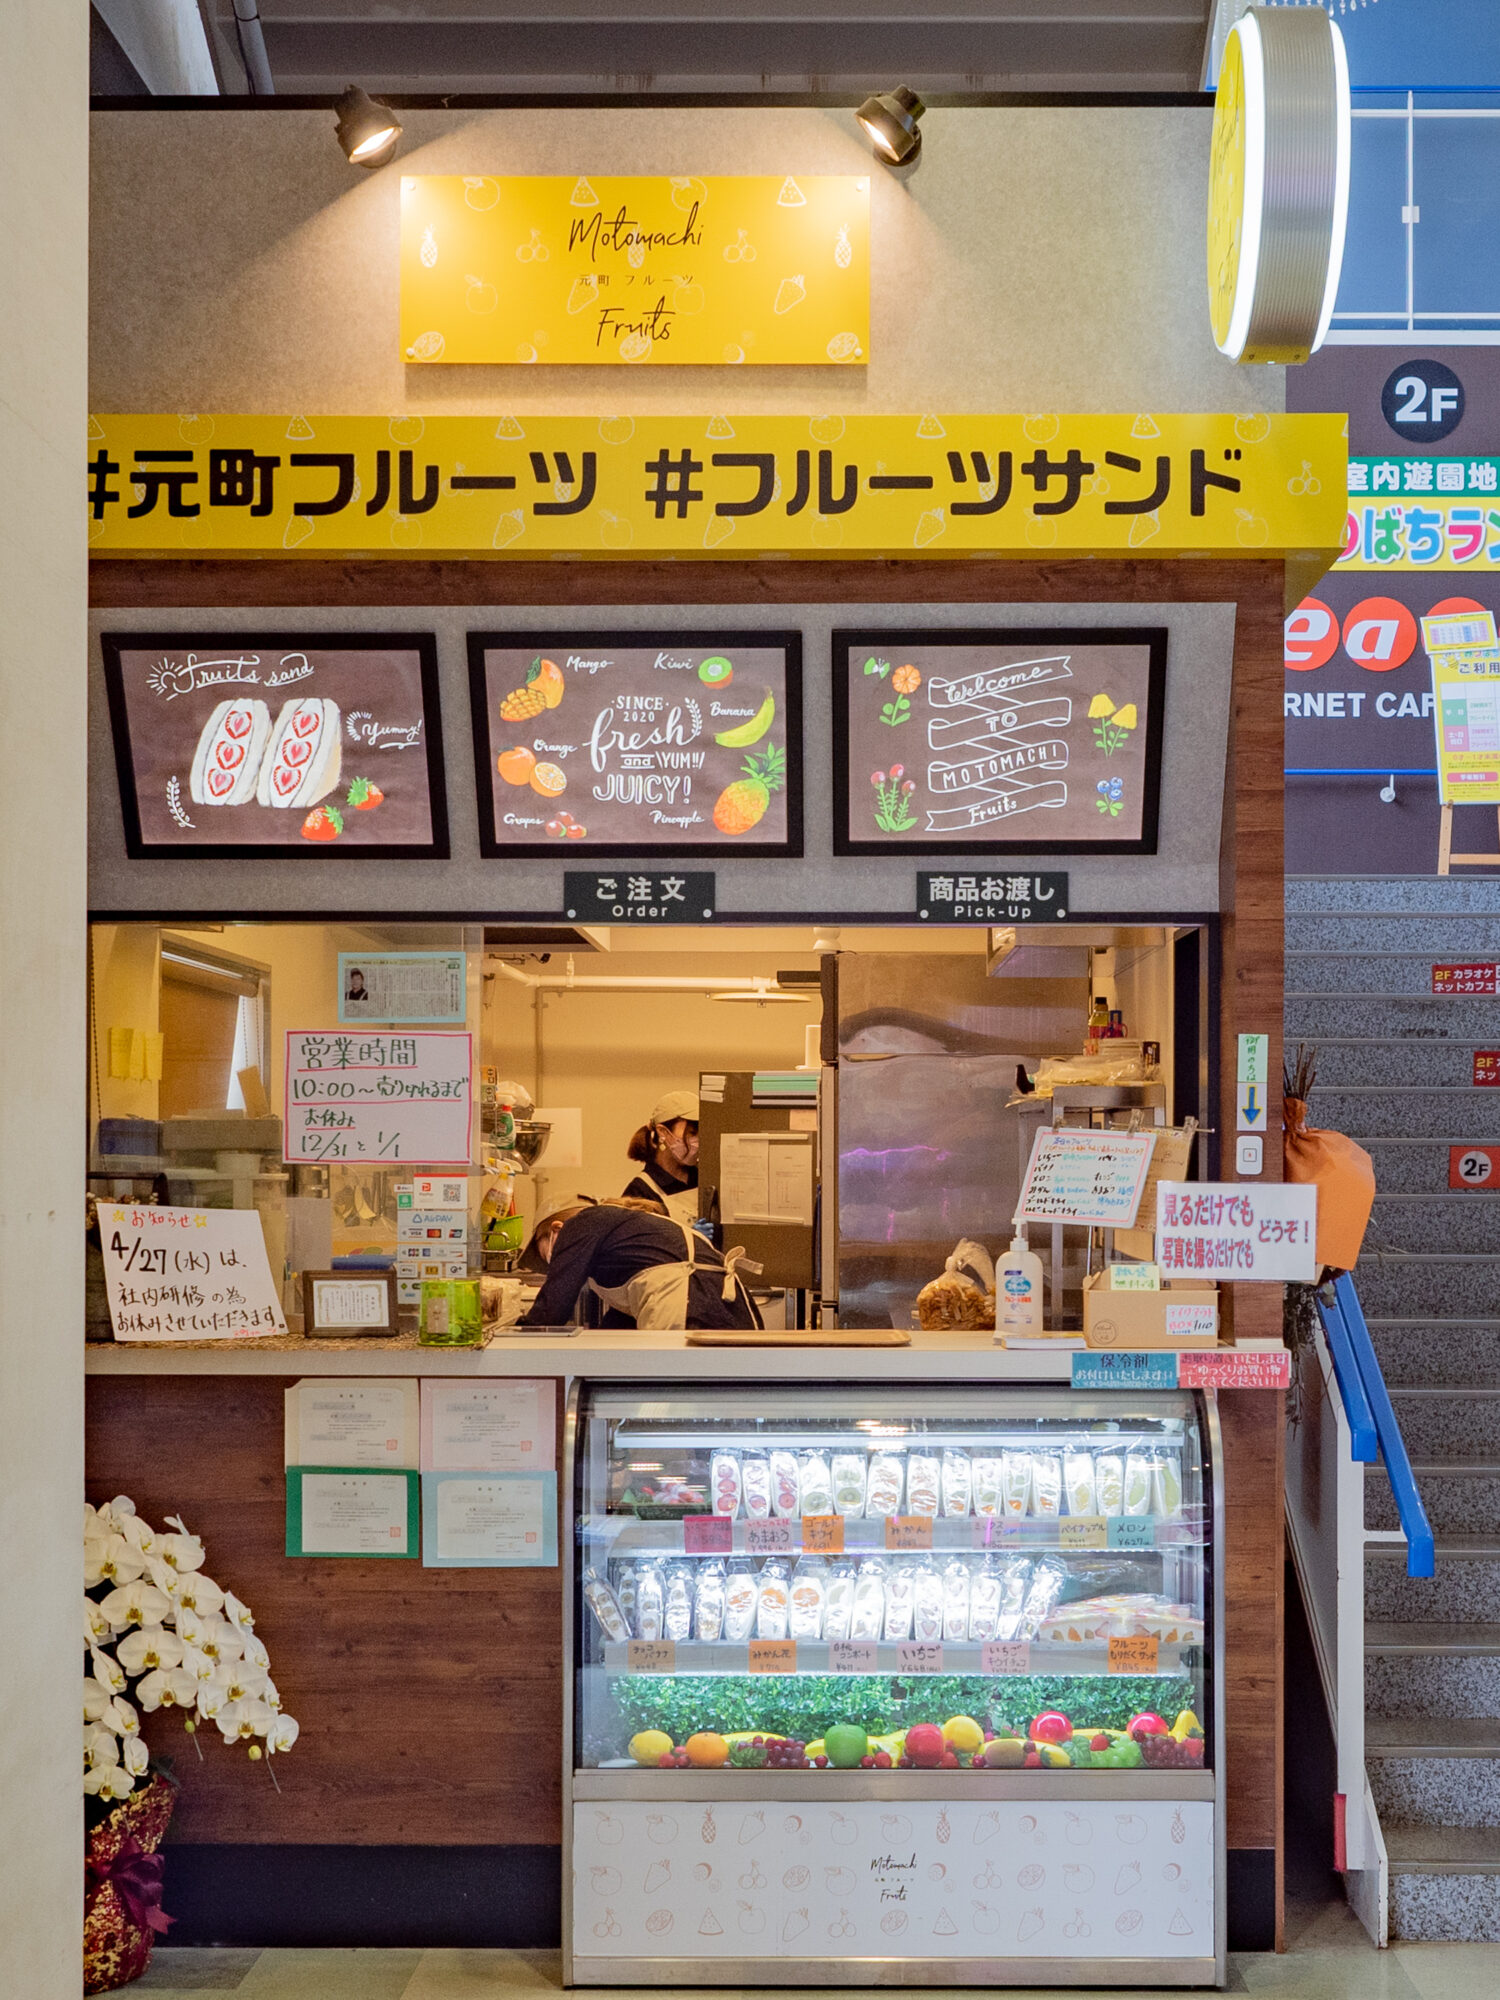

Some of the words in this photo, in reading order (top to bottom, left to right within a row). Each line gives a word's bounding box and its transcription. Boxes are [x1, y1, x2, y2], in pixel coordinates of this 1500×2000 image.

[568, 200, 705, 263] Motomachi
[579, 274, 610, 287] 元町
[625, 274, 694, 287] フルーツ
[596, 295, 677, 348] Fruits
[1394, 376, 1459, 422] 2F
[88, 449, 597, 520] #元町フルーツ
[645, 448, 1242, 520] #フルーツサンド
[1347, 461, 1498, 492] 室内遊園地
[566, 655, 615, 675] Mango
[653, 653, 694, 671] Kiwi
[172, 653, 262, 694] Fruits
[264, 653, 315, 687] sand
[945, 666, 1053, 703] Welcome
[616, 695, 664, 711] SINCE
[710, 702, 757, 718] Banana
[1284, 691, 1367, 718] RNET
[623, 712, 656, 723] 2020
[985, 711, 1018, 733] TO
[361, 719, 422, 746] Yummy!
[582, 706, 694, 773] fresh
[533, 739, 579, 759] Orange
[624, 756, 651, 767] and
[942, 743, 1058, 790] MOTOMACHI
[592, 774, 692, 805] JUICY!
[967, 796, 1018, 825] Fruits
[650, 810, 705, 832] Pineapple
[595, 876, 687, 903] ご注文
[928, 876, 1056, 903] 商品お渡し
[611, 904, 669, 919] Order
[953, 904, 1033, 920] Pick-Up
[1434, 970, 1452, 981] 2F
[1453, 968, 1494, 979] カラオケ
[1434, 981, 1495, 993] ネットカフェ
[300, 1036, 417, 1070] 営業時間
[1476, 1057, 1494, 1068] 2F
[303, 1108, 355, 1128] お休み
[1463, 1157, 1489, 1177] 2F
[131, 1210, 192, 1228] お知らせ
[1163, 1193, 1254, 1227] 見るだけでも
[1162, 1237, 1254, 1269] 写真を撮るだけでも
[118, 1282, 247, 1307] 社内研修の為
[117, 1306, 287, 1333] お休みさせていただきます。
[1101, 1353, 1149, 1368] 保冷剤
[747, 1528, 790, 1543] あまおう
[809, 1529, 834, 1541] キウイ
[891, 1526, 927, 1536] みかん
[1061, 1523, 1106, 1535] パイナップル
[1116, 1523, 1146, 1533] メロン
[902, 1644, 941, 1660] いちご
[989, 1643, 1022, 1657] いちご
[1112, 1638, 1149, 1649] フルーツ
[879, 1885, 909, 1903] Fruits
